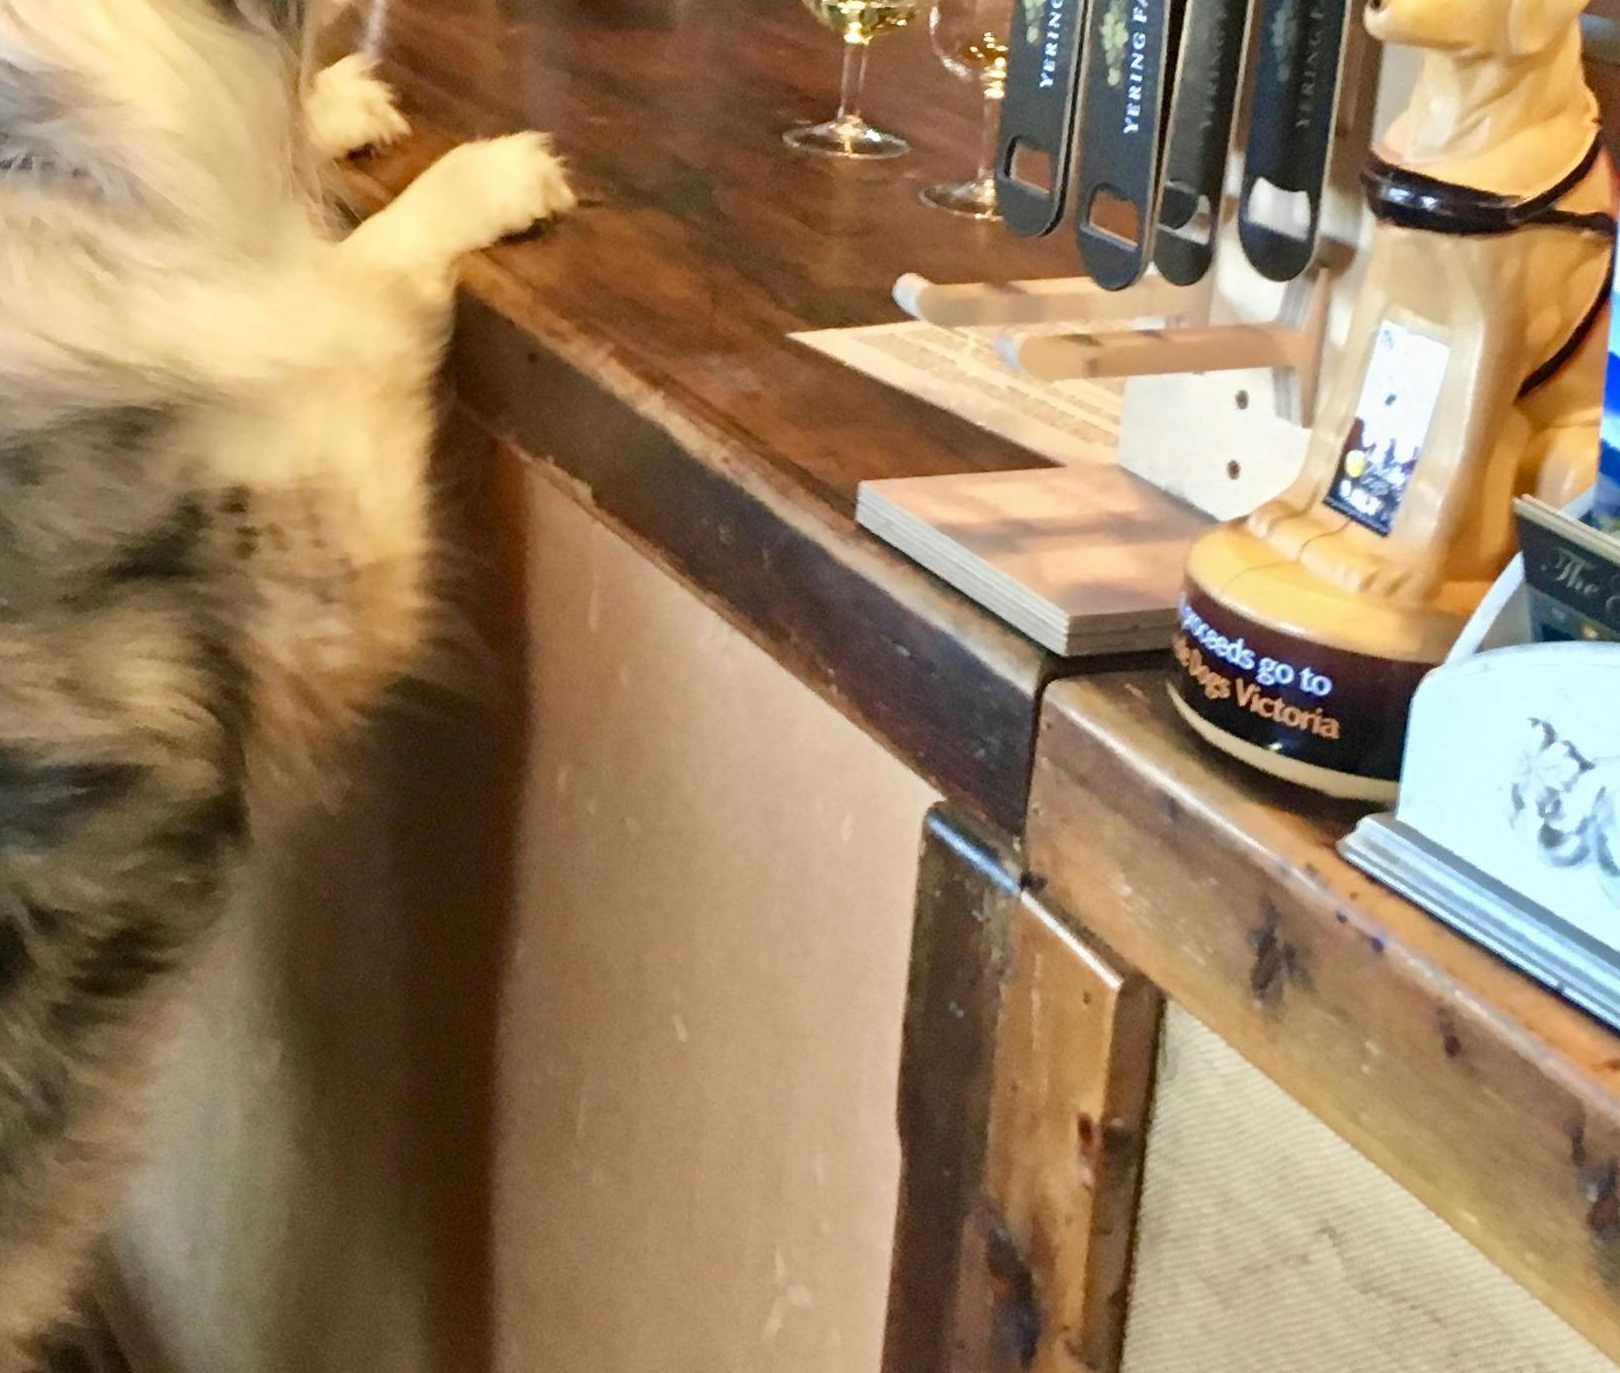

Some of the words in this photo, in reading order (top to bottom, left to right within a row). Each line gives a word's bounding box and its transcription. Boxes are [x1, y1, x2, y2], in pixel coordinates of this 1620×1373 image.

[1123, 32, 1146, 135] YERING
[1255, 657, 1295, 686] go
[1299, 666, 1332, 696] to
[1235, 678, 1341, 740] Victoria
